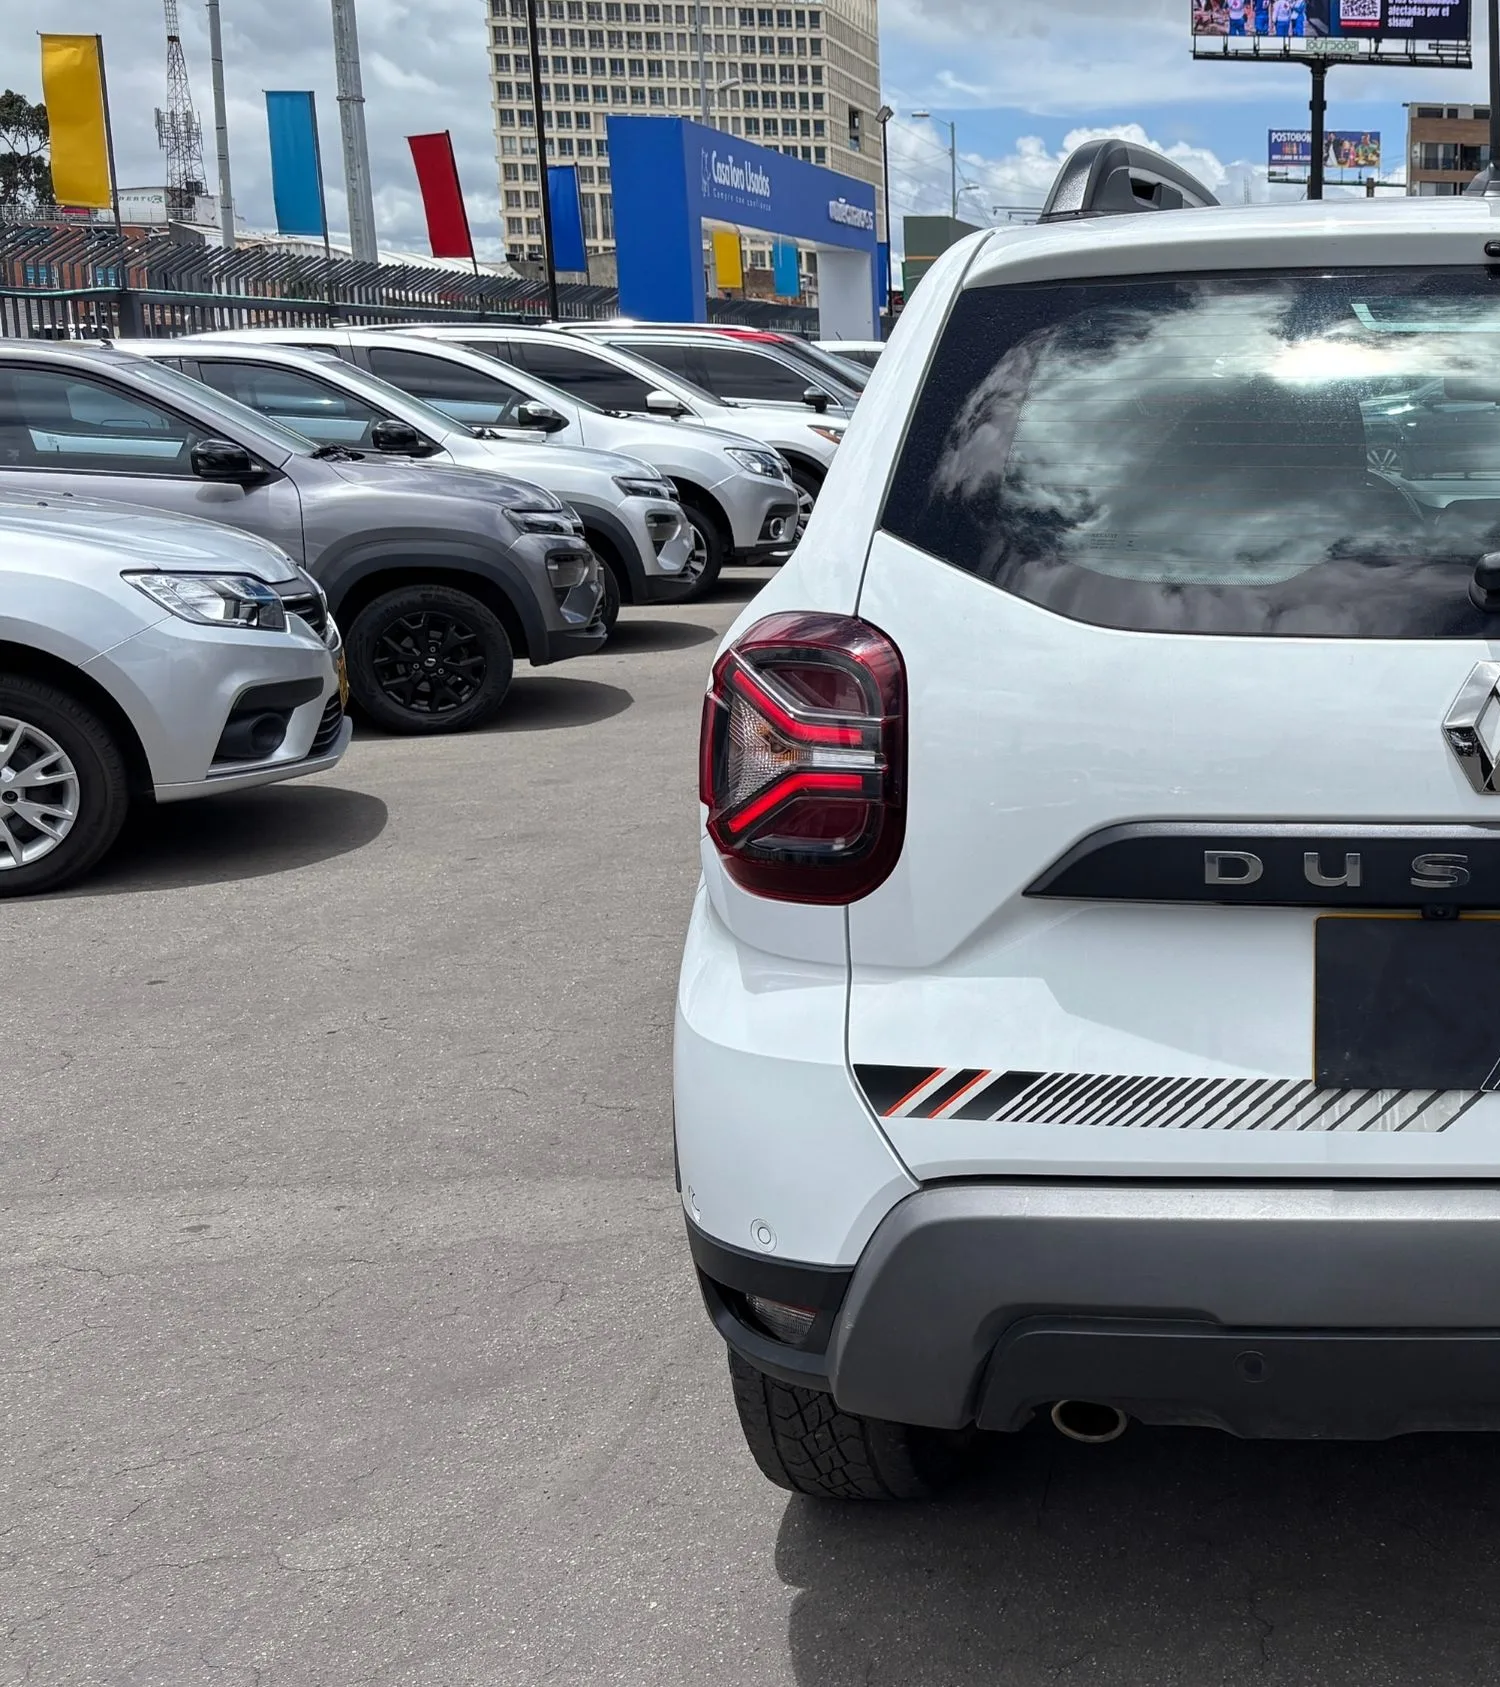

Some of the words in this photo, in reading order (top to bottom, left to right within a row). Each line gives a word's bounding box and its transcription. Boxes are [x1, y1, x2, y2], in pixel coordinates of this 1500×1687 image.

[1388, 5, 1425, 16] afectadas
[1427, 6, 1441, 17] por
[1441, 6, 1450, 16] el
[1388, 17, 1414, 28] sismo!
[711, 150, 745, 191] CasaToro
[744, 160, 770, 198] Usados
